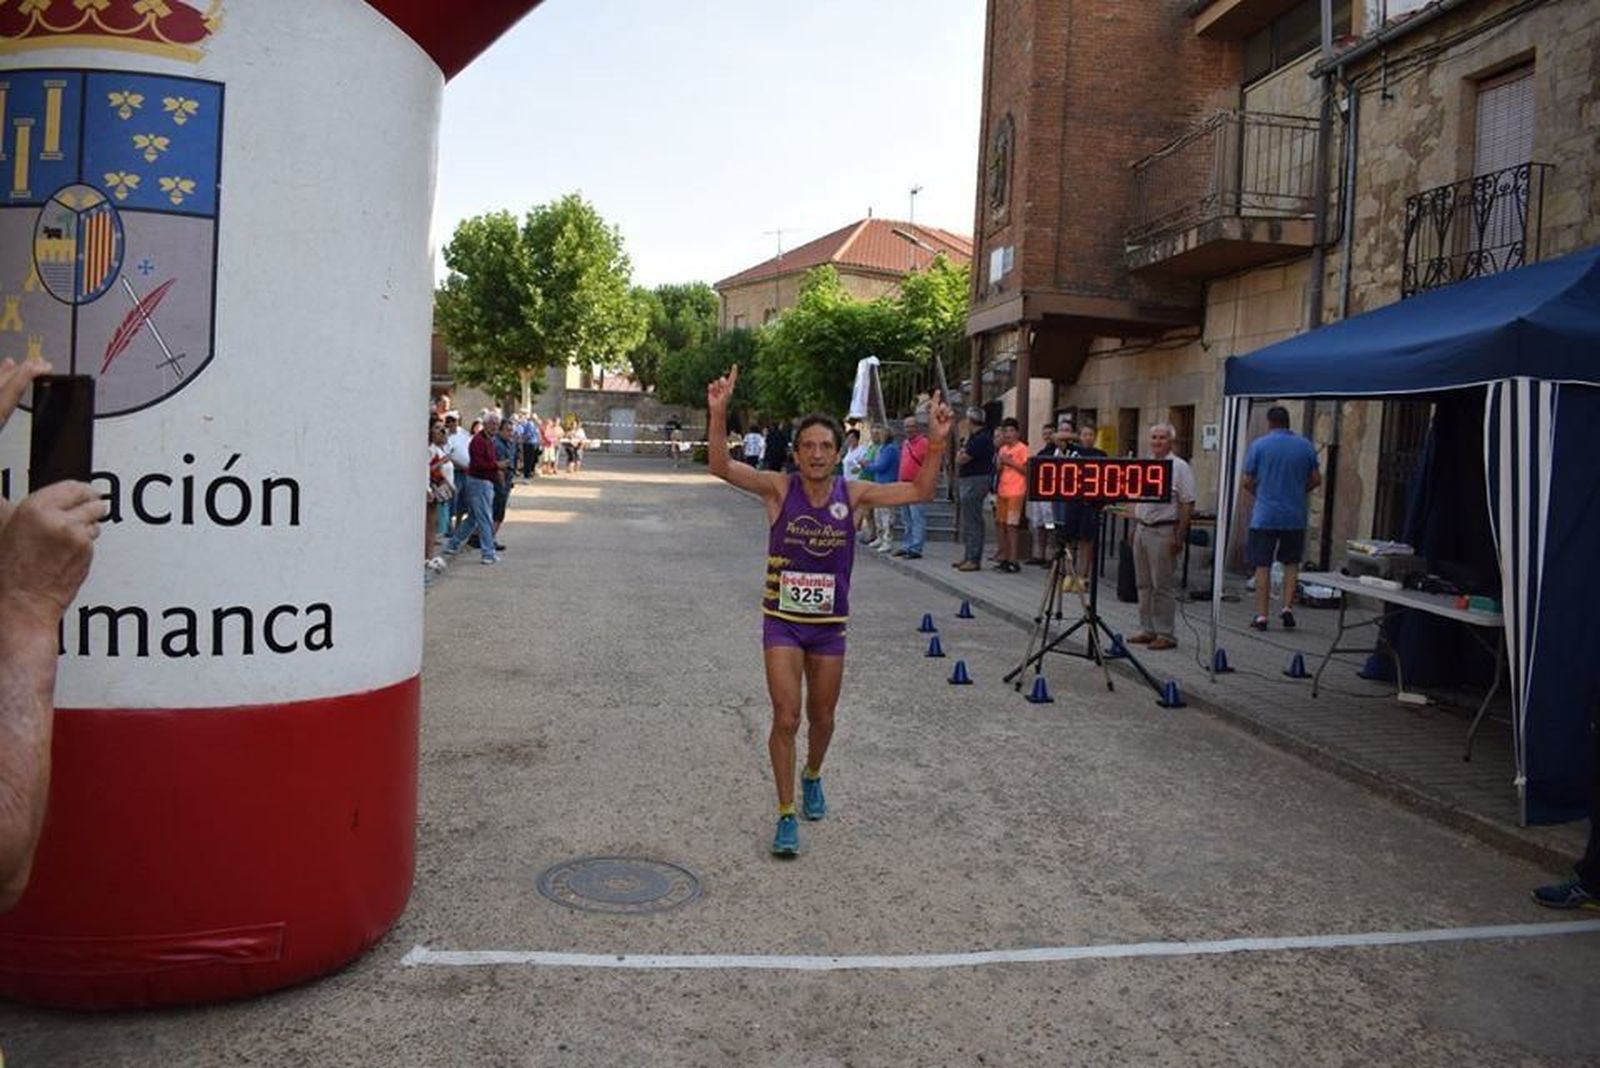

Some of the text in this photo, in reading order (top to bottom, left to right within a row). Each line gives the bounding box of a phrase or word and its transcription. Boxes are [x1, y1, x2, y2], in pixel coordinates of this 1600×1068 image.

[1038, 463, 1163, 497] 00:30:09
[791, 587, 824, 603] 325
[57, 601, 334, 658] manca
